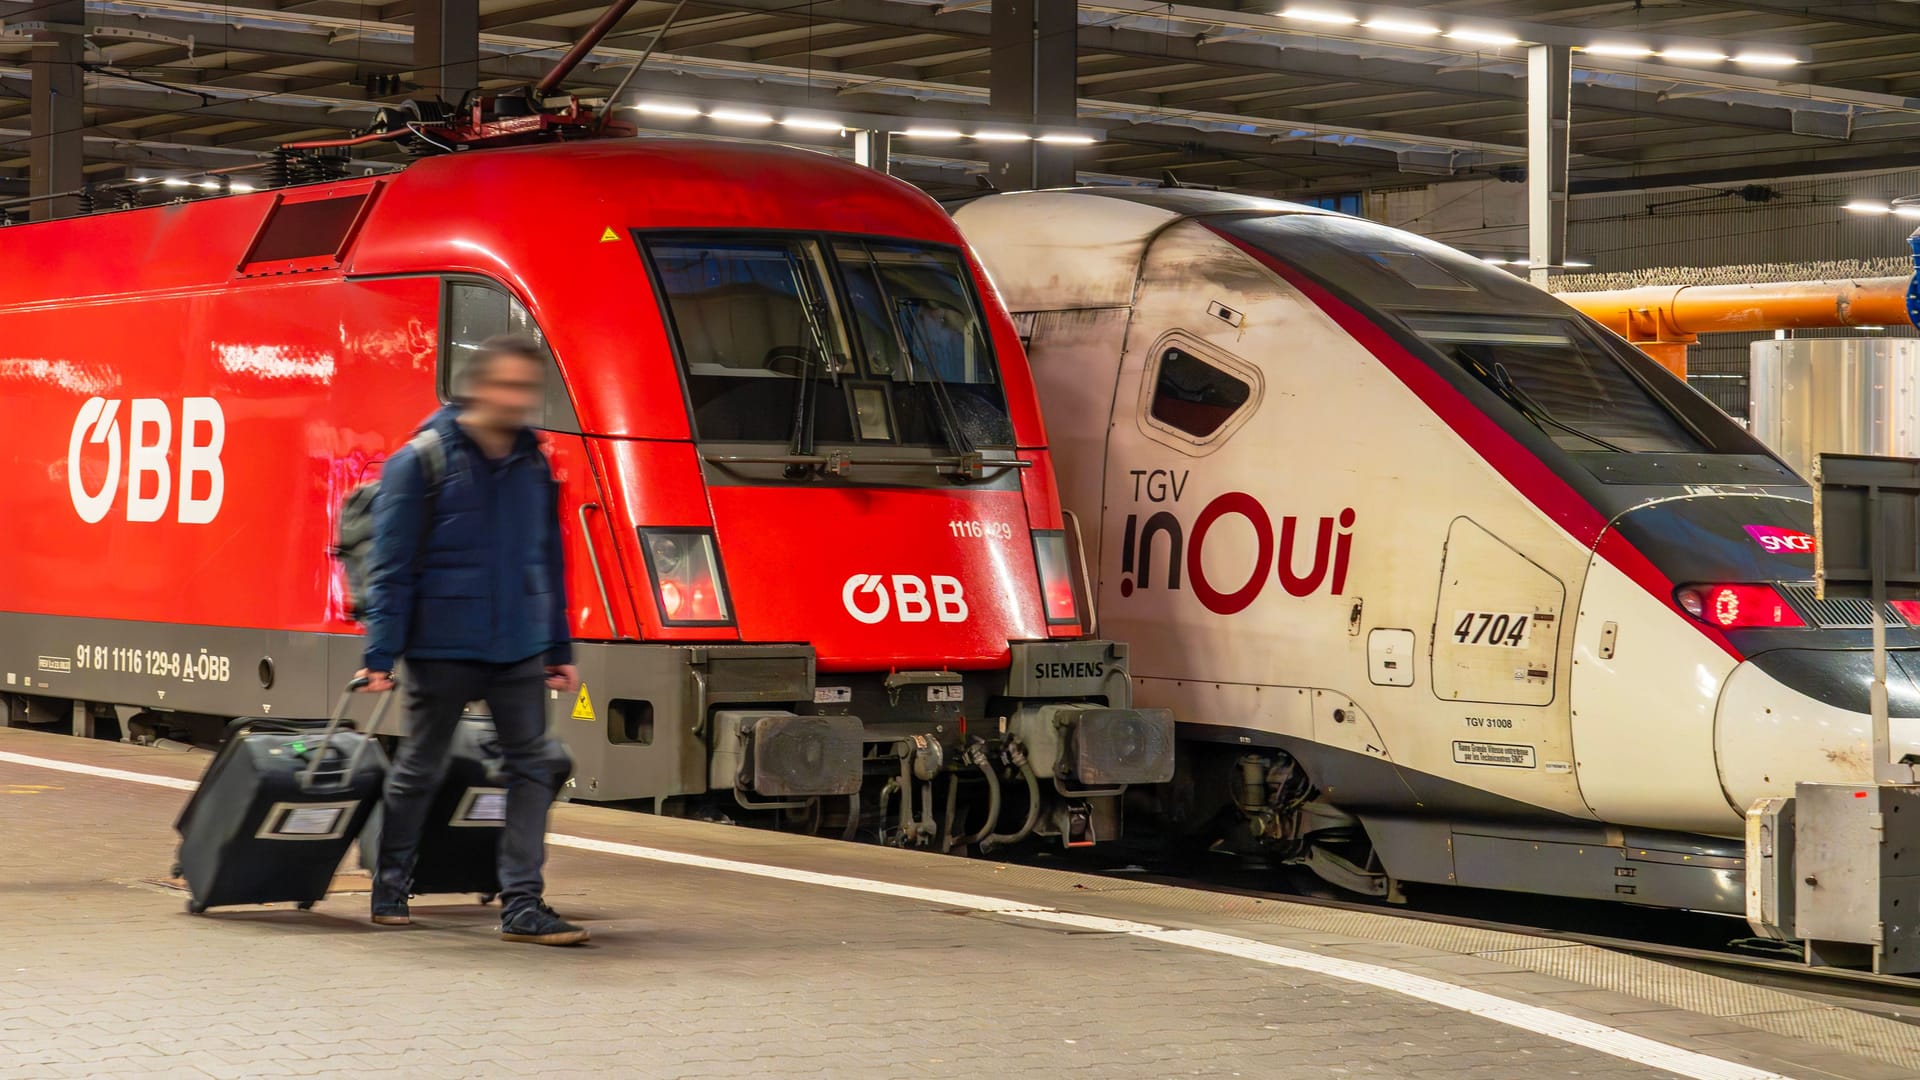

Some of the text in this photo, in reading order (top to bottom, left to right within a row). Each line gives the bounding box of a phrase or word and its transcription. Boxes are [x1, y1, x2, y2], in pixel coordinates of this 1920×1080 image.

[68, 396, 225, 525] ÖBB
[1130, 469, 1189, 502] TGV
[948, 520, 1012, 540] 1116 29
[1760, 535, 1813, 550] SNCF
[842, 573, 969, 624] ÖBB
[1454, 612, 1528, 647] 4704
[76, 644, 91, 668] 91
[94, 646, 108, 670] 81
[112, 647, 142, 674] 1116
[145, 650, 180, 678] 129-8
[182, 648, 230, 683] A-ÖBB
[1035, 661, 1104, 679] SIEMENS
[1465, 717, 1513, 729] TGV 31008
